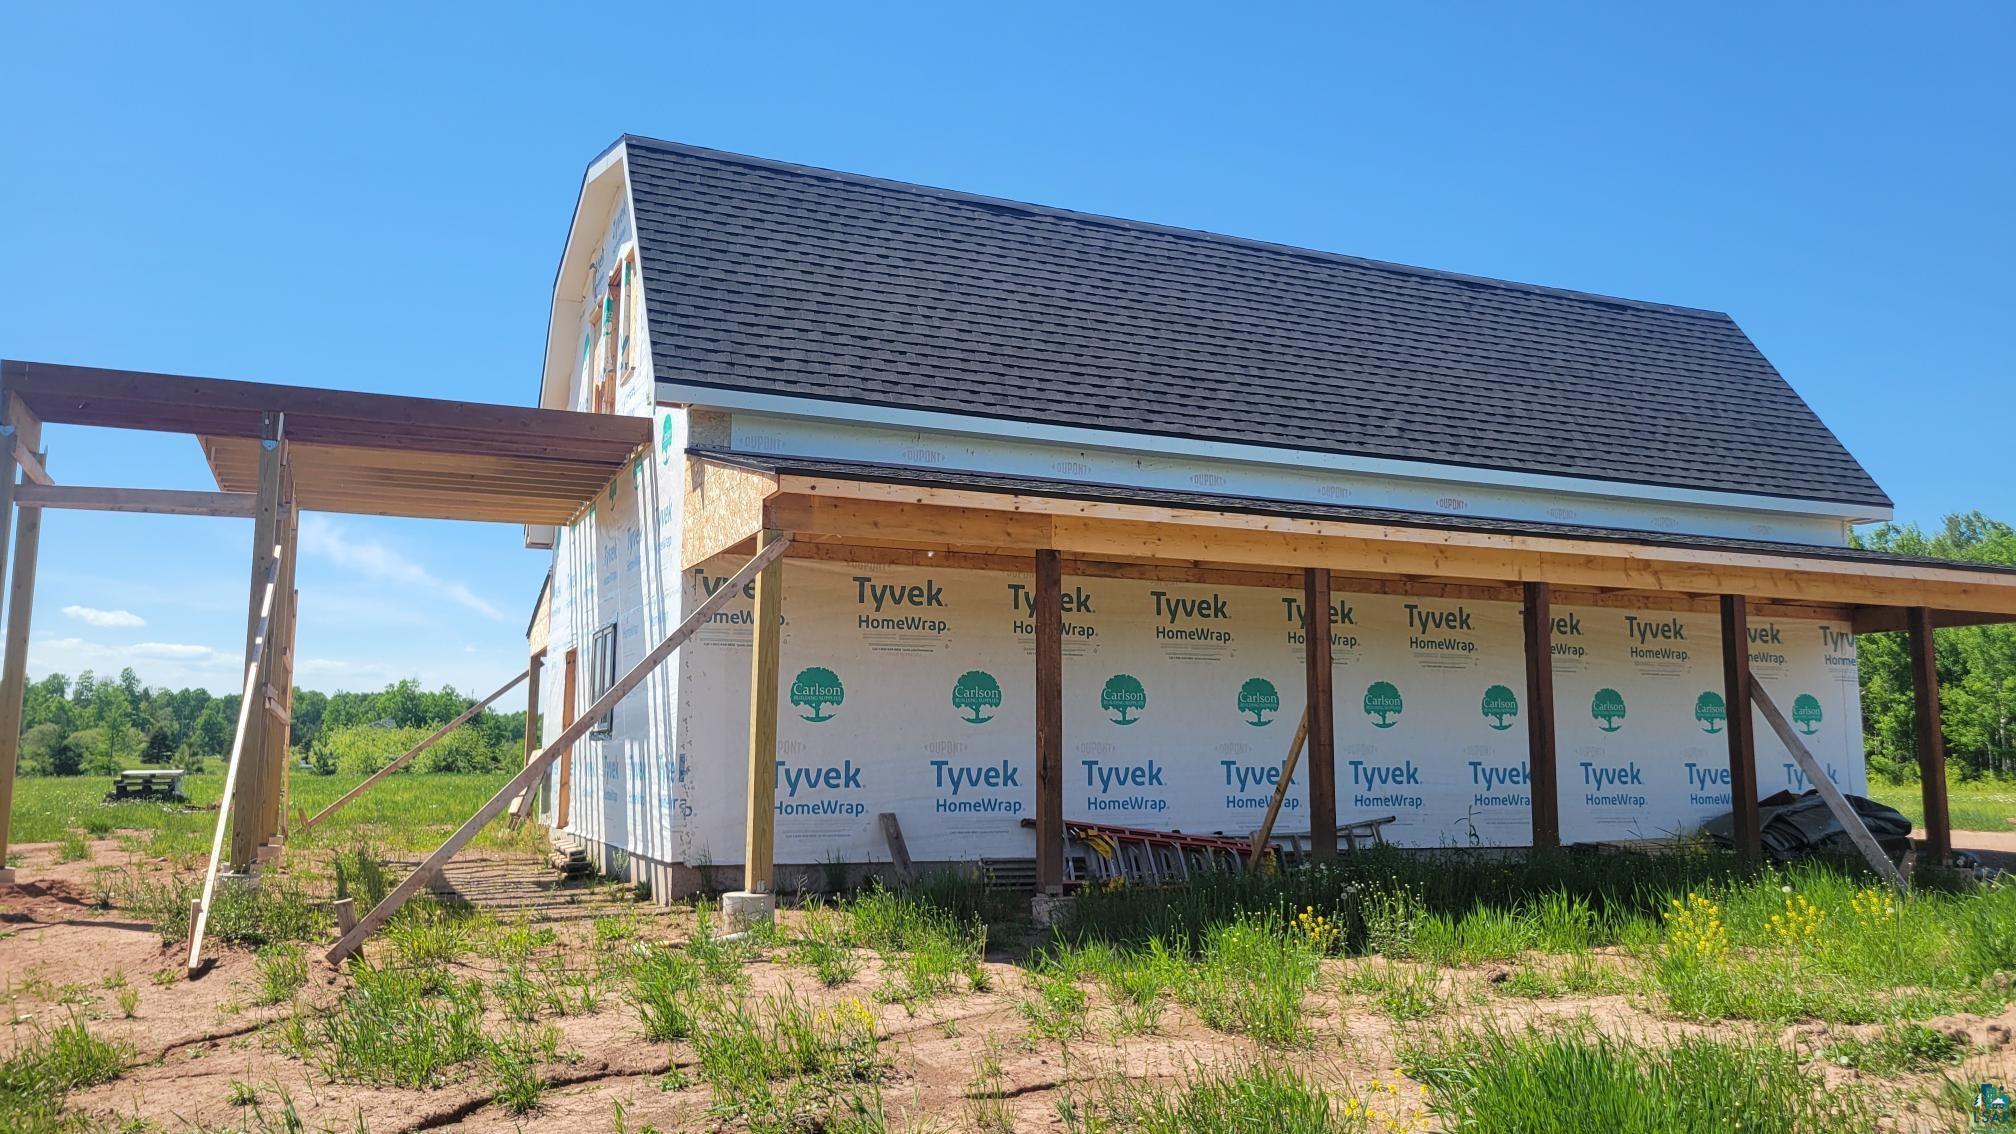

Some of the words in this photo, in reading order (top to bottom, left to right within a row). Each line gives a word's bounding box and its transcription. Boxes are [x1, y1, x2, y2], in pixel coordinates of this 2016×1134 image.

[905, 449, 943, 463] DUPONT
[1056, 461, 1088, 476] DUPONT
[1193, 473, 1223, 487] DUPONT
[1439, 498, 1465, 510] DUPONT
[1008, 584, 1091, 618] Tyek
[858, 615, 947, 634] HomeWrap
[1156, 626, 1231, 643] HomeWrap
[1410, 637, 1475, 653] HomeWrap
[1630, 646, 1688, 661] HomeWrap
[793, 683, 841, 696] Carlson
[955, 686, 999, 698] Carlson
[1103, 689, 1144, 701] Carlson
[1240, 691, 1277, 704] Carlson
[1365, 694, 1400, 706] Carlson
[1484, 697, 1516, 709] Carlson
[1593, 701, 1624, 711] Carlson
[1697, 703, 1725, 713] Carlson
[1794, 706, 1821, 715] Carlson
[1685, 763, 1730, 791] Tyve
[936, 799, 1022, 815] HomeWrap
[1088, 797, 1166, 812] HomeWrap
[1355, 795, 1423, 809] HomeWrap
[1475, 794, 1530, 807] HomeWra
[1586, 794, 1645, 808] HomeWrap
